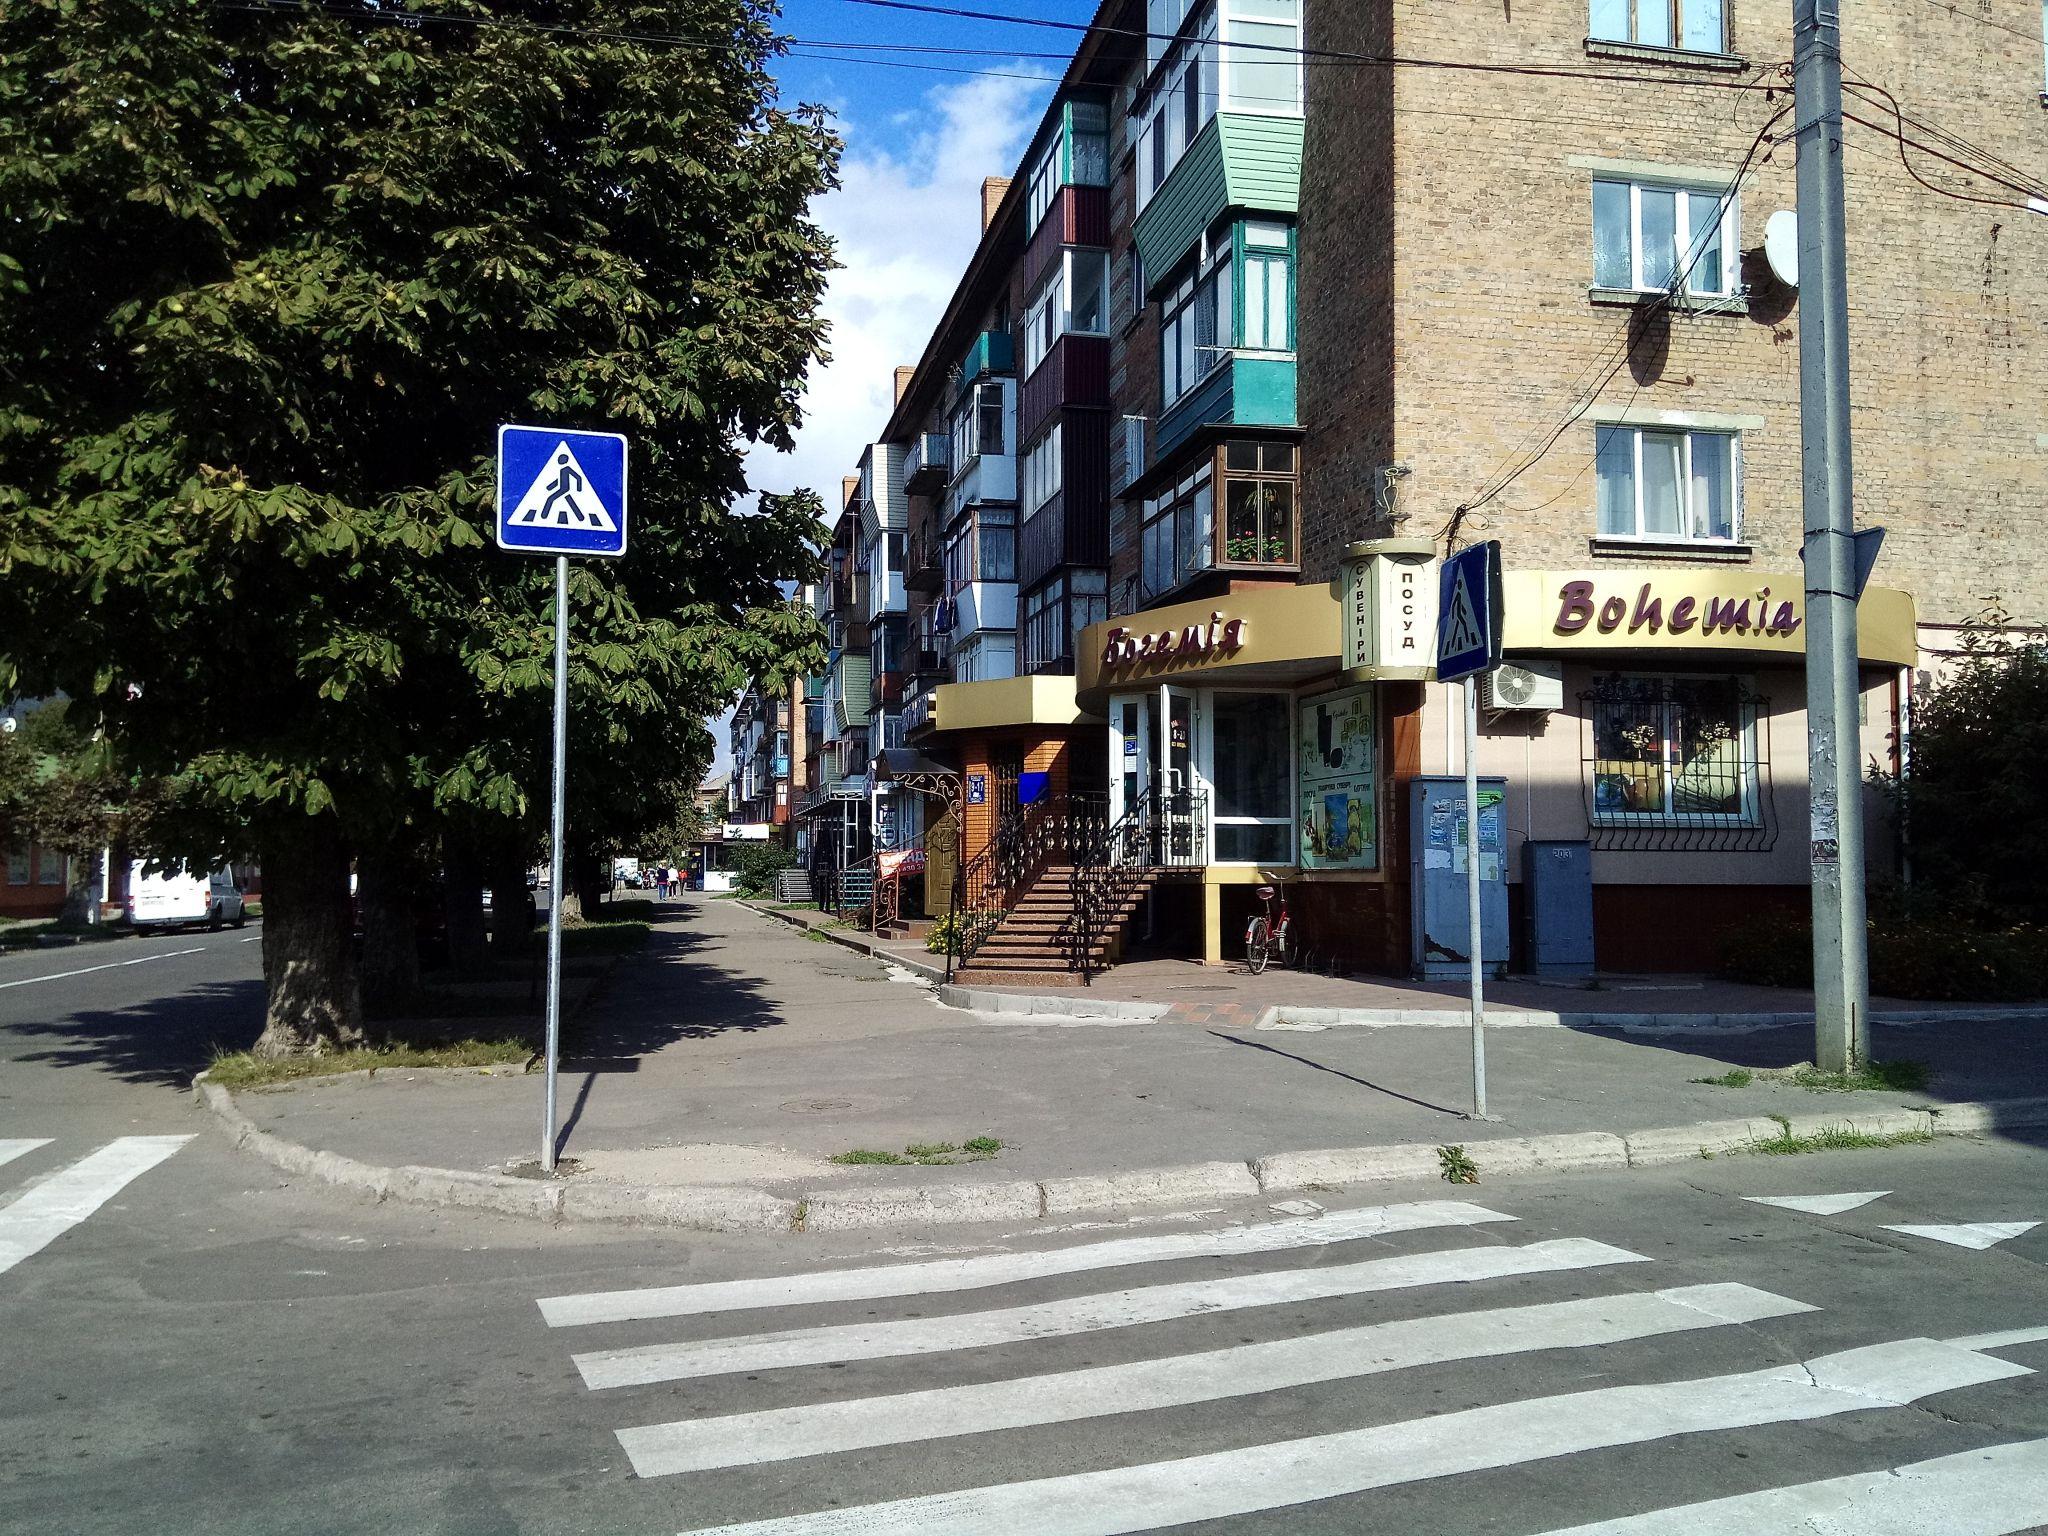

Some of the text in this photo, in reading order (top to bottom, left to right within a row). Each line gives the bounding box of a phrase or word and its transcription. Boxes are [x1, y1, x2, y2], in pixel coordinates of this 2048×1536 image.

[1356, 565, 1366, 663] СУВЕНІРИ
[1402, 572, 1415, 649] ПОСУД
[1555, 580, 1802, 632] Bohemia
[1106, 611, 1248, 666] Богемія
[1554, 849, 1569, 859] 203
